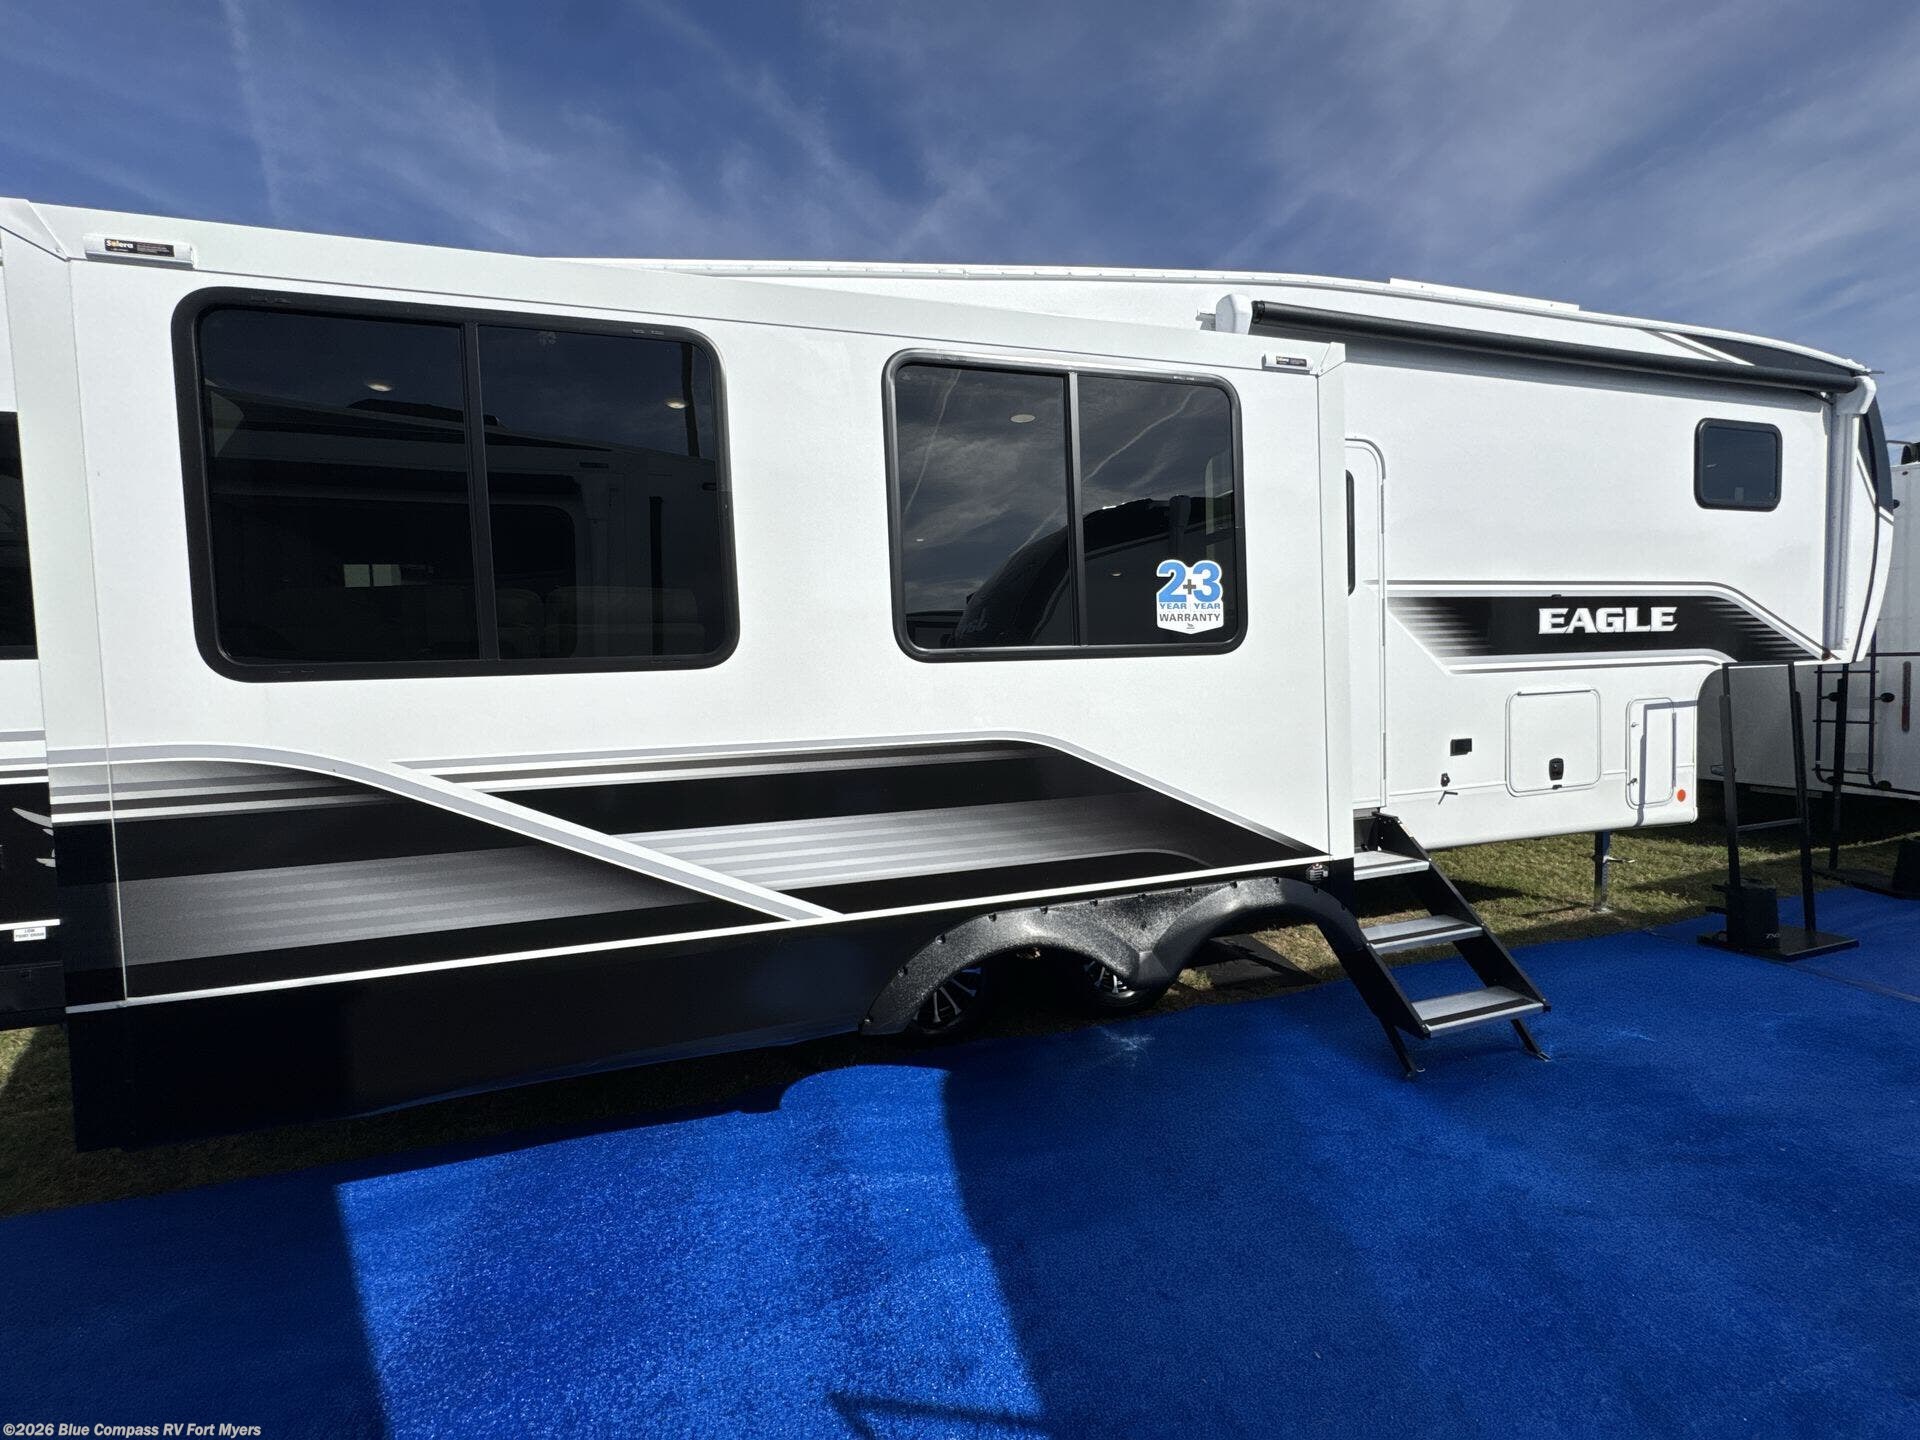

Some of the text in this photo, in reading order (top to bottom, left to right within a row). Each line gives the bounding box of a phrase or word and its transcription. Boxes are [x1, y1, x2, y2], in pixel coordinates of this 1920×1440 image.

[106, 239, 134, 249] Solera
[1159, 613, 1221, 622] WARRANTY
[1538, 607, 1678, 634] EAGLE
